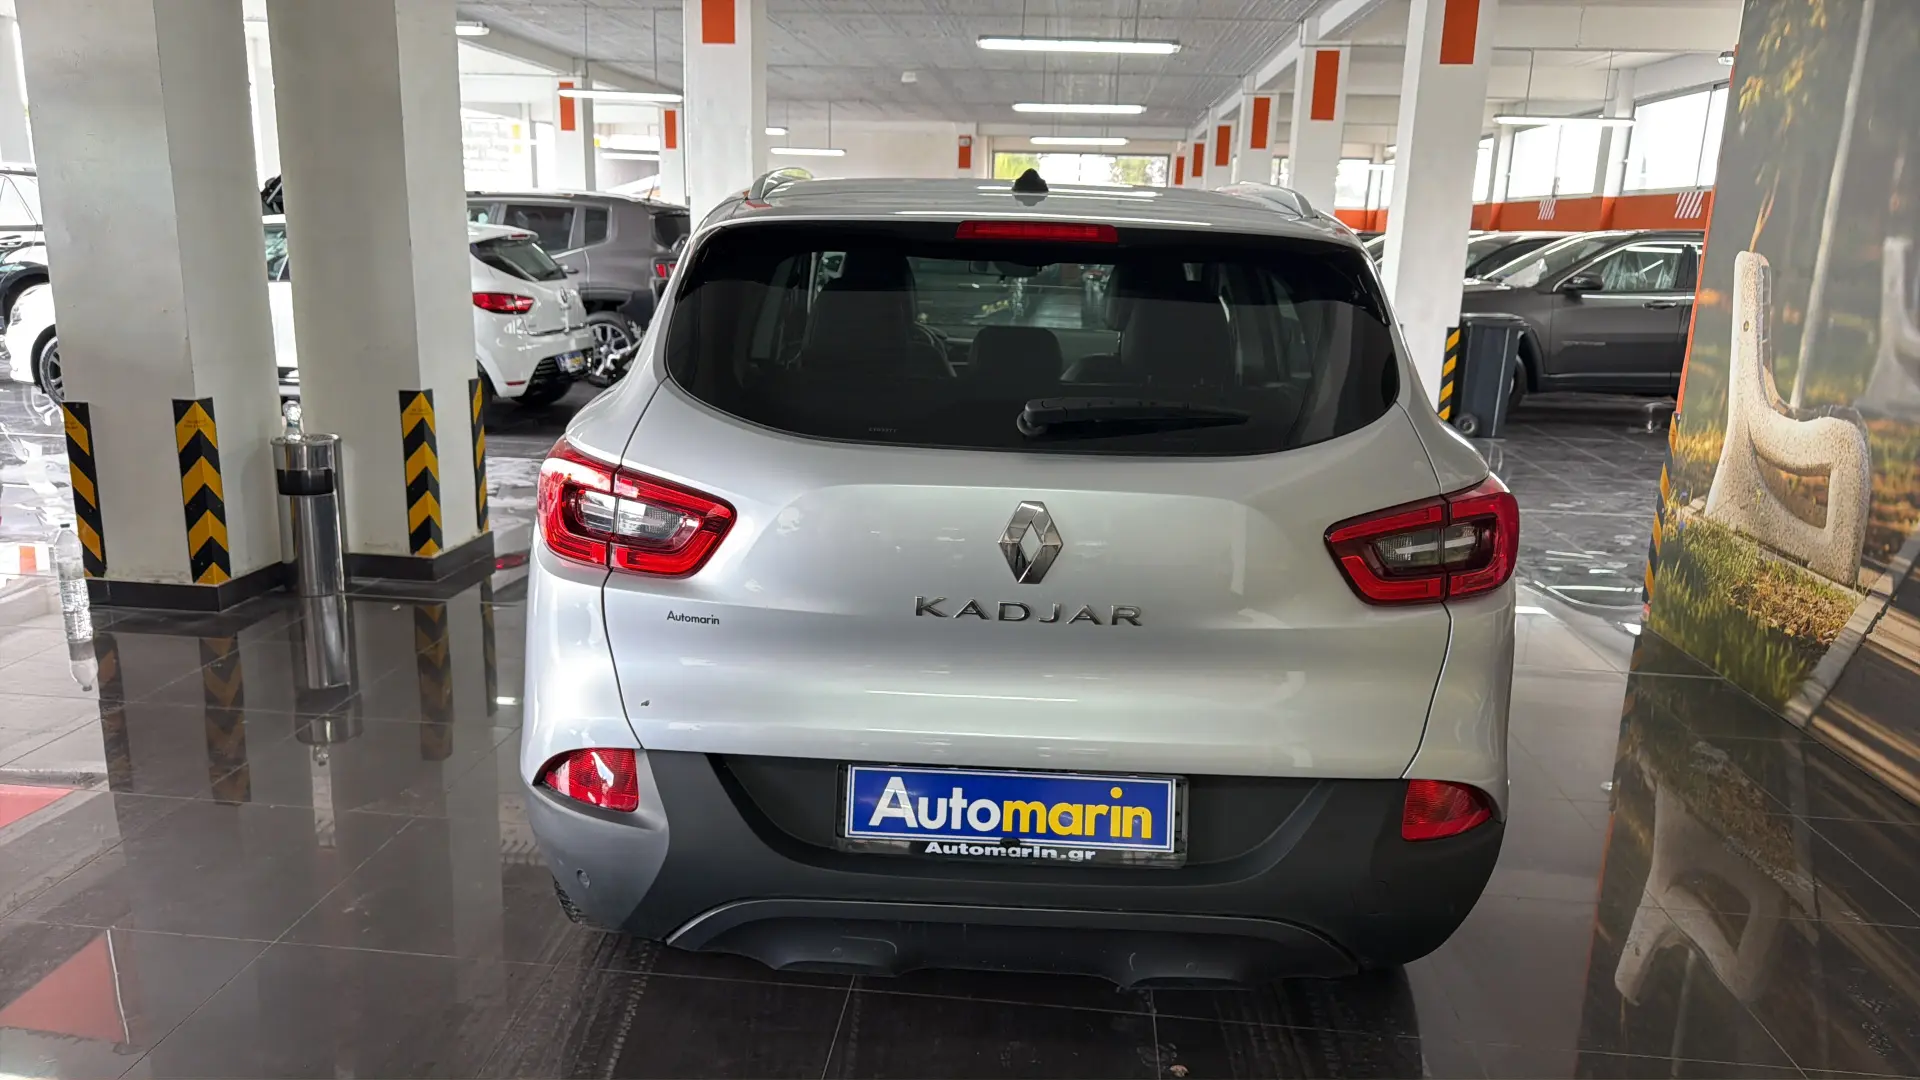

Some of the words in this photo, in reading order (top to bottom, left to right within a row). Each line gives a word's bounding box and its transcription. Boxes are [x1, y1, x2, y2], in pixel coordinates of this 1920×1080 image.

[667, 610, 720, 625] Automarin
[915, 596, 1143, 627] KADJAR
[868, 776, 1152, 839] Automarin
[925, 842, 1096, 862] Automarin.gr
